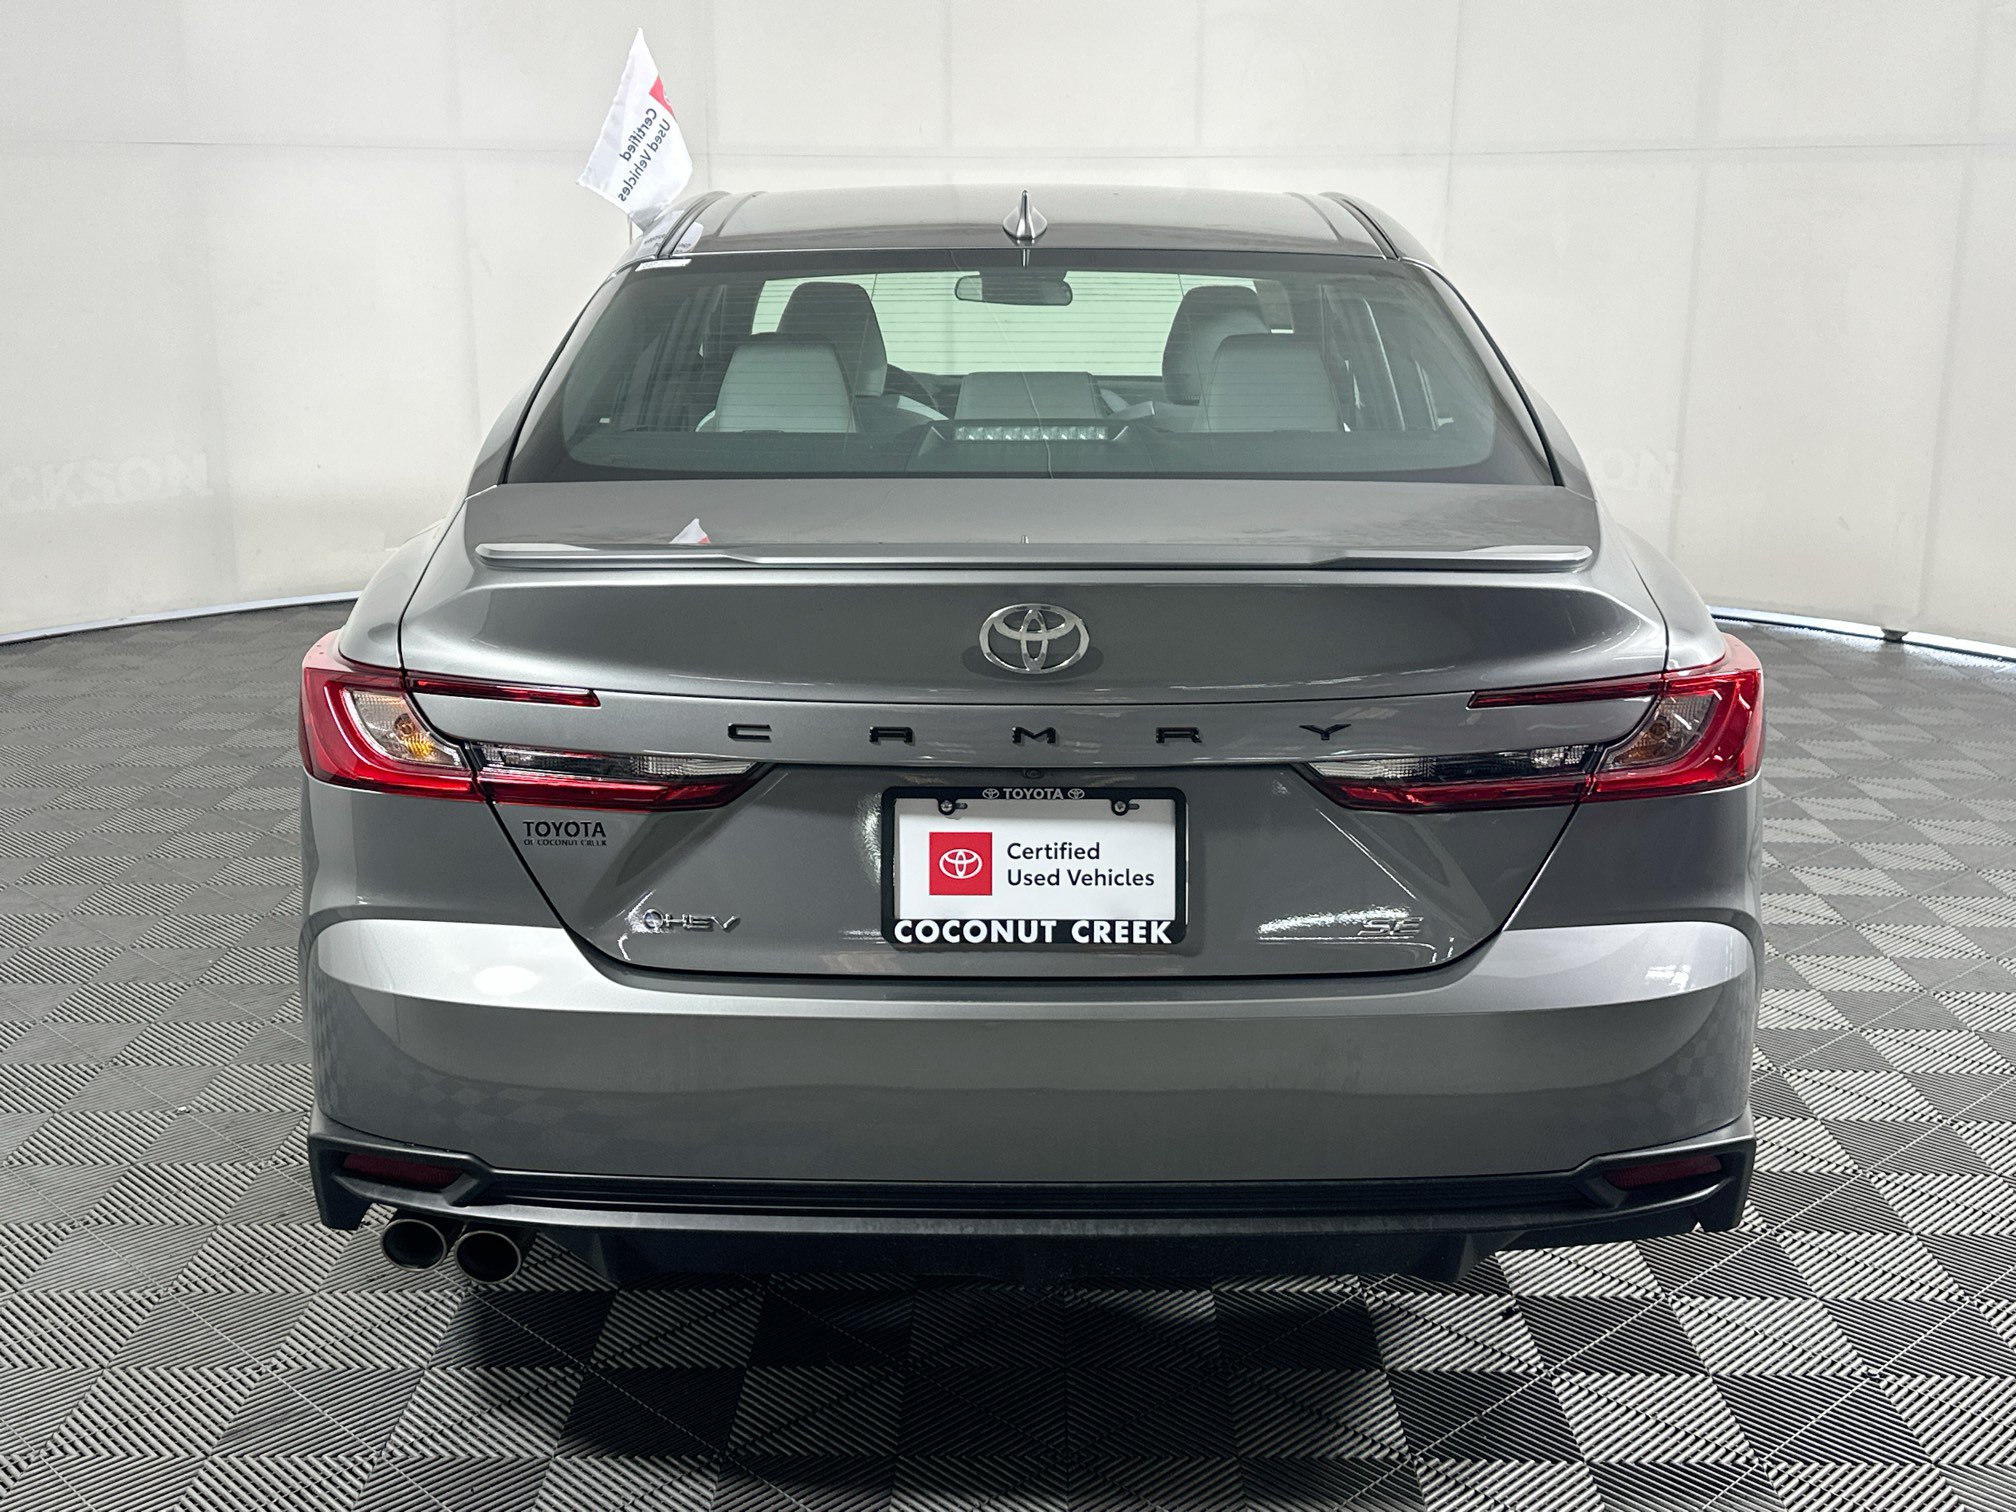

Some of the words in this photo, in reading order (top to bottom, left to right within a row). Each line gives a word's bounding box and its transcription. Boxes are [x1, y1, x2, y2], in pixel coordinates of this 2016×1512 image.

[728, 723, 1352, 744] CAMRY
[1002, 788, 1064, 800] TOYOTA
[522, 821, 606, 837] TOYOTA
[1006, 841, 1100, 861] Certified
[1006, 868, 1060, 886] Used
[1067, 868, 1155, 886] Vehicles
[893, 919, 1057, 944] COCONUT
[1071, 919, 1173, 944] CREEK
[1356, 916, 1424, 937] SE
